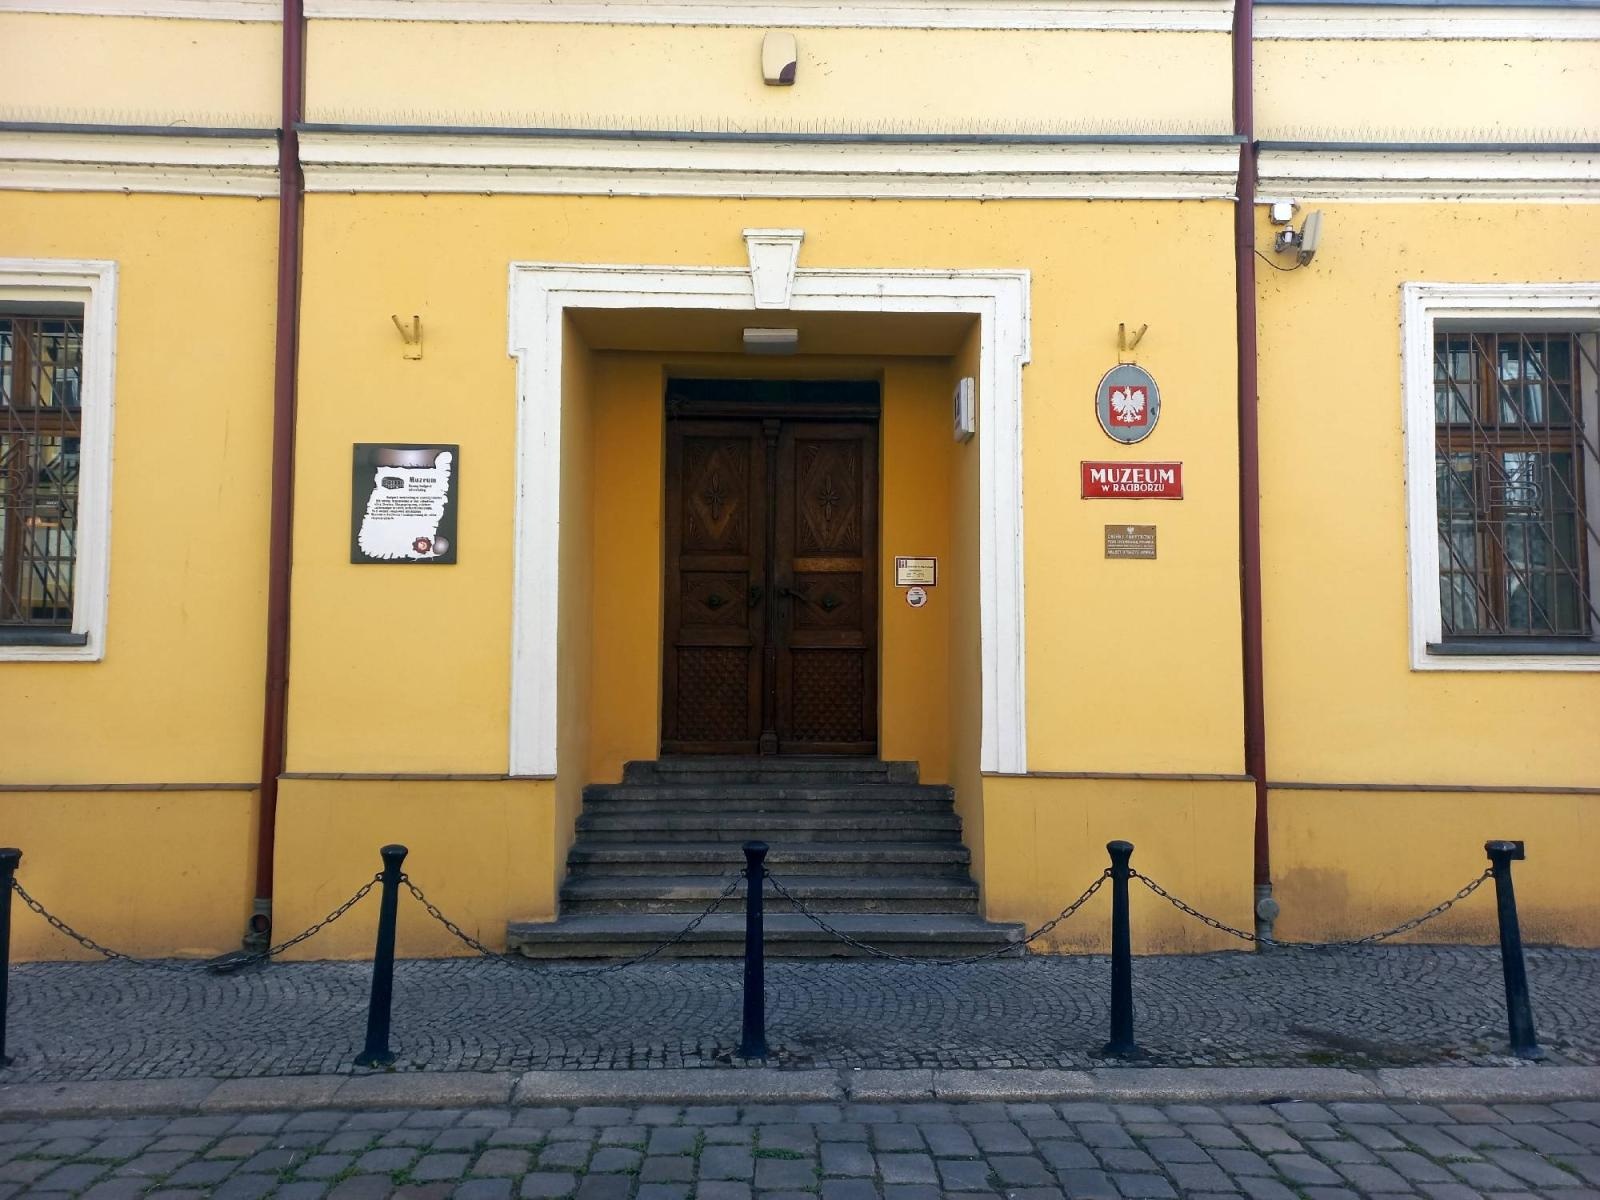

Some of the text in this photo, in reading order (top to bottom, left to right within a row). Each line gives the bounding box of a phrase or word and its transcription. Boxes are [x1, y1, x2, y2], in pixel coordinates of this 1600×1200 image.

[409, 476, 437, 484] Muzeum
[1090, 468, 1175, 484] MUZEUM
[1113, 484, 1164, 492] RACIBORZU
